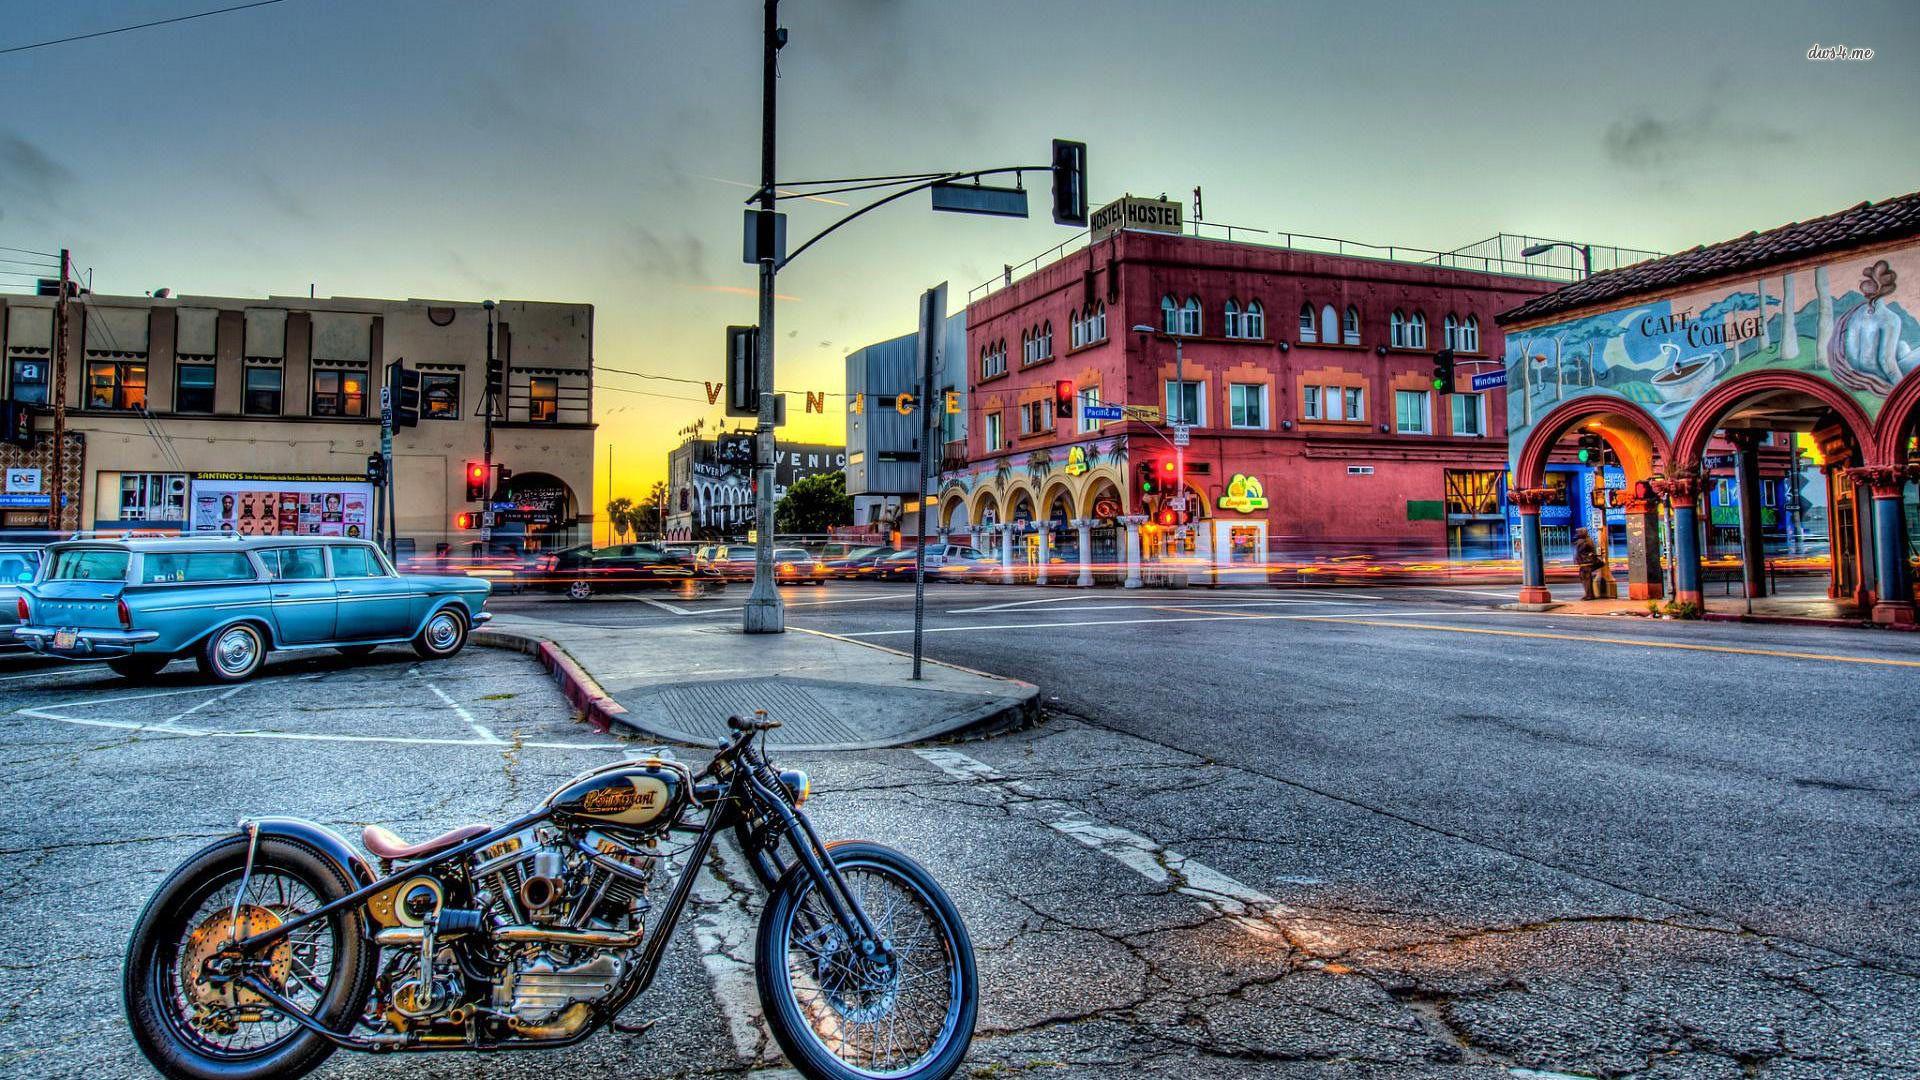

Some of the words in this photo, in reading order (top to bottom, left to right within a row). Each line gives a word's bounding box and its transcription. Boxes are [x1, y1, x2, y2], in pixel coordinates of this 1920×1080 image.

[1091, 203, 1123, 233] HOSTEL
[1128, 204, 1181, 226] HOSTEL
[1641, 306, 1694, 338] CAFÉ
[1687, 316, 1765, 349] COLLAGE
[22, 364, 38, 379] a
[1087, 408, 1110, 417] Pacific
[1111, 409, 1120, 417] Av
